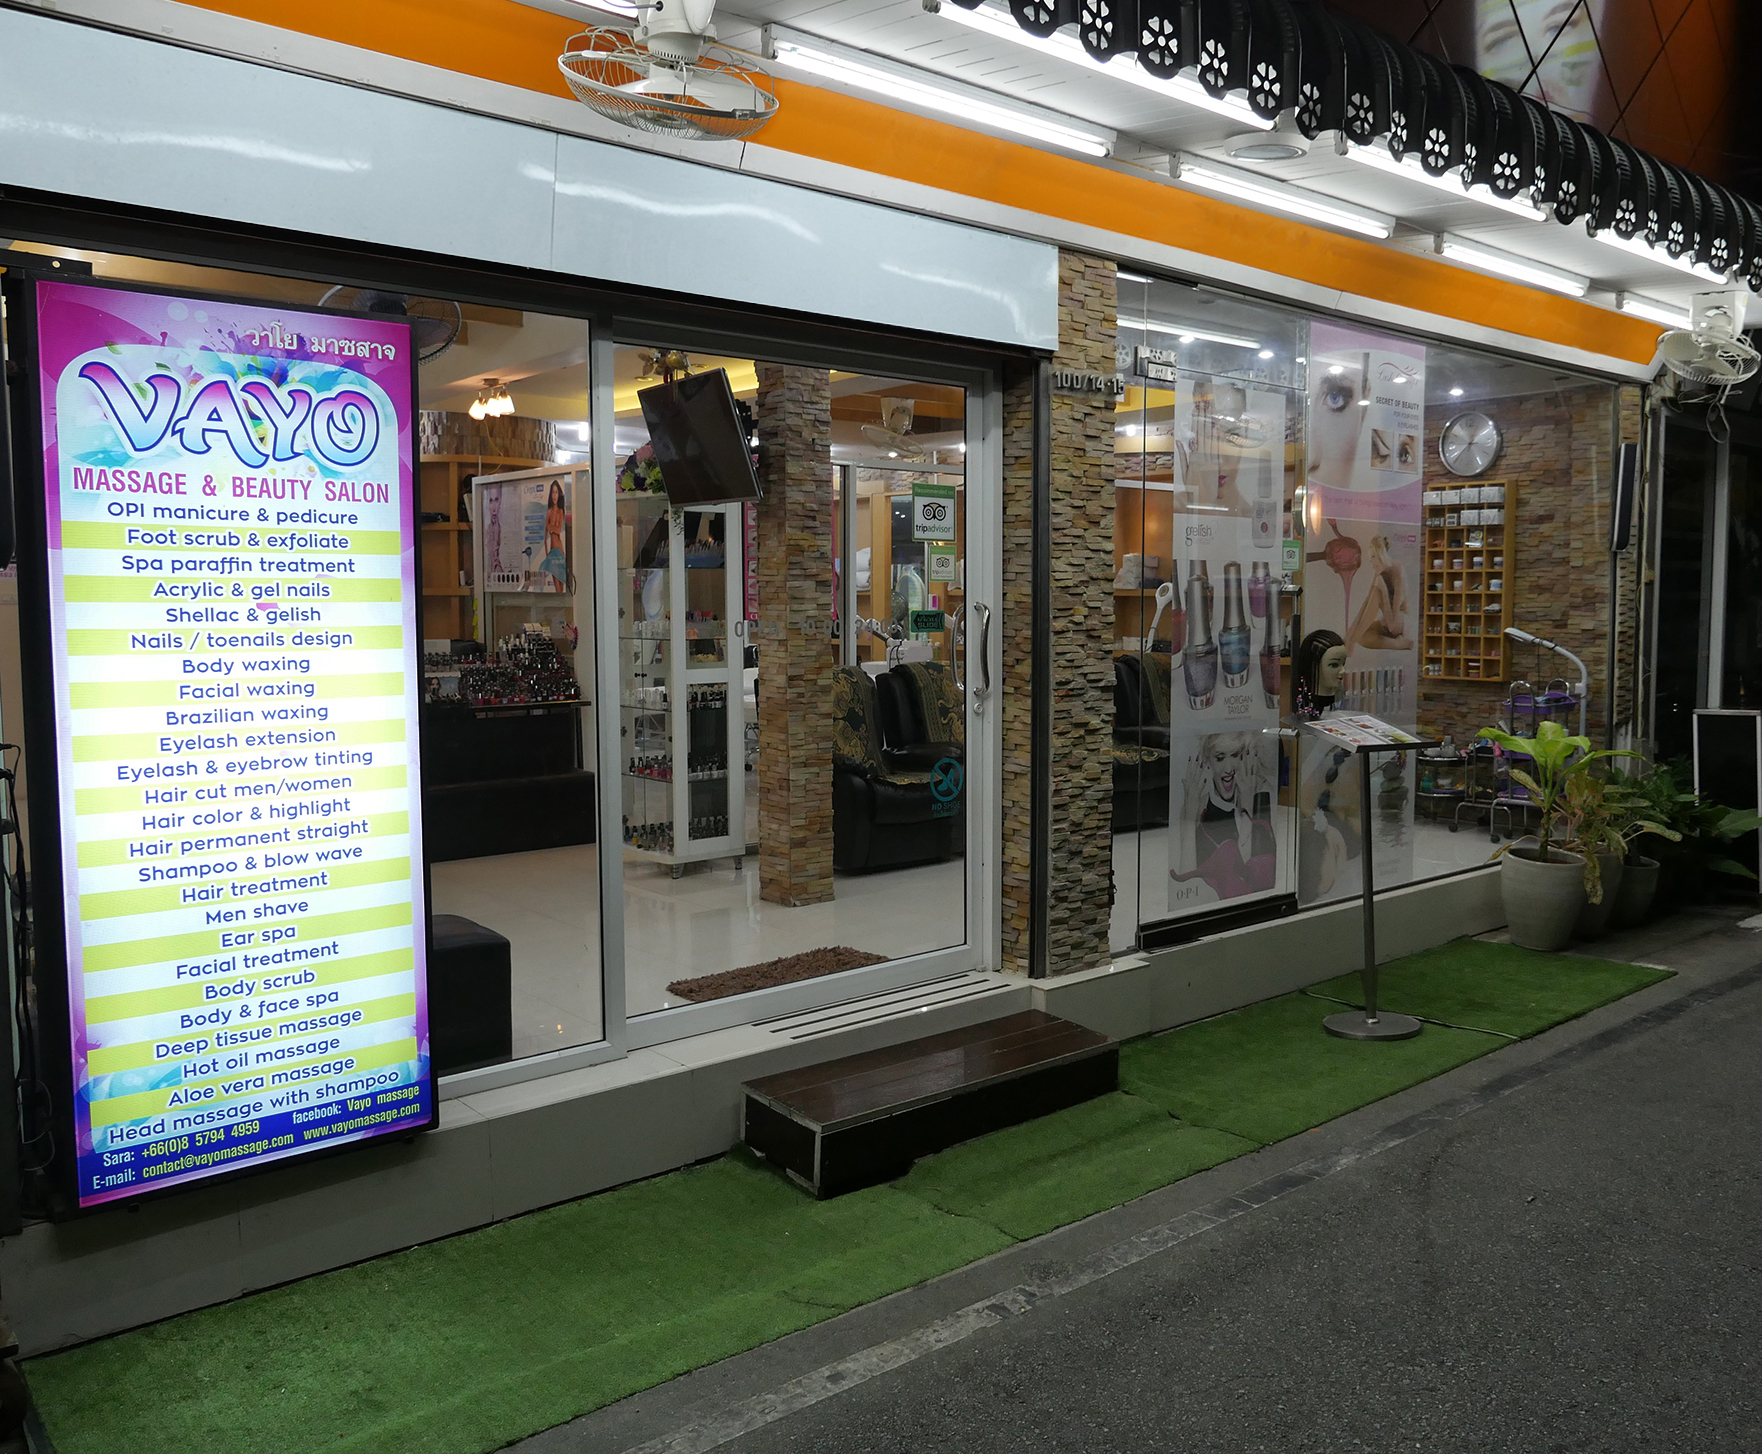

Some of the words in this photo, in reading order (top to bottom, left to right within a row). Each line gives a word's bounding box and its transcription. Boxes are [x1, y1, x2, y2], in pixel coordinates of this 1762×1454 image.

[246, 321, 298, 350] วาโย
[78, 361, 380, 468] VAYO
[1376, 396, 1394, 406] SECRET
[1402, 401, 1419, 410] BEAUTY
[73, 467, 187, 495] MASSAGE
[202, 474, 217, 497] &
[232, 476, 312, 500] BEAUTY
[325, 480, 389, 504] SALON
[107, 501, 145, 518] OPI
[153, 504, 250, 521] manicure
[256, 507, 269, 522] &
[276, 508, 358, 526] pedicure
[128, 529, 177, 545] Foot
[184, 531, 241, 546] scrub
[247, 532, 260, 547] &
[267, 532, 349, 551] exfoliate
[916, 524, 952, 534] tripadvisor
[1184, 523, 1212, 547] gelish
[121, 555, 163, 574] Spa
[171, 556, 252, 575] paraffin
[259, 557, 355, 573] treatment
[153, 581, 224, 600] Acrylic
[231, 582, 244, 597] &
[251, 582, 280, 600] gel
[287, 582, 330, 597] nails
[166, 607, 239, 623] Shellac
[246, 607, 259, 622] &
[266, 607, 321, 625] gelish
[734, 620, 780, 638] OPEN
[131, 633, 183, 649] Nails
[189, 632, 200, 650] /
[206, 631, 285, 648] toenails
[291, 631, 352, 648] design
[182, 658, 234, 676] Body
[241, 656, 310, 673] waxing
[179, 683, 239, 699] Facial
[246, 681, 315, 698] waxing
[1224, 694, 1253, 706] MORGAN
[166, 708, 254, 726] Brazilian
[261, 704, 328, 721] waxing
[1227, 705, 1250, 714] TAYLOR
[160, 733, 238, 754] Eyelash
[245, 728, 336, 747] extension
[117, 761, 198, 783] Eyelash
[205, 760, 218, 774] &
[226, 756, 308, 775] eyebrow
[314, 750, 373, 766] tinting
[145, 787, 188, 804] Hair
[195, 784, 227, 800] cut
[234, 777, 352, 797] men/women
[142, 813, 185, 830] Hair
[192, 809, 243, 826] color
[250, 806, 262, 820] &
[269, 798, 351, 820] highlight
[931, 802, 942, 810] NO
[943, 800, 960, 810] SHOE
[130, 839, 173, 857] Hair
[181, 827, 291, 856] permanent
[297, 819, 369, 840] straight
[138, 861, 238, 882] Shampoo
[245, 856, 257, 870] &
[264, 852, 309, 868] blow
[315, 847, 363, 862] wave
[182, 884, 224, 903] Hair
[230, 871, 328, 897] treatment
[206, 909, 246, 925] Men
[253, 901, 309, 919] shave
[221, 932, 255, 948] Ear
[261, 927, 296, 943] spa
[176, 956, 236, 979] Facial
[243, 941, 339, 969] treatment
[205, 979, 256, 1000] Body
[263, 969, 315, 990] scrub
[180, 1008, 232, 1029] Body
[239, 1004, 252, 1018] &
[258, 998, 300, 1019] face
[306, 991, 339, 1008] spa
[155, 1039, 209, 1059] Deep
[215, 1027, 272, 1047] tissue
[279, 1010, 362, 1036] massage
[183, 1058, 220, 1079] Hot
[225, 1052, 249, 1070] oil
[255, 1038, 340, 1064] massage
[168, 1087, 215, 1107] Aloe
[221, 1076, 264, 1095] vera
[271, 1058, 355, 1085] massage
[109, 1118, 166, 1145] Head
[173, 1101, 264, 1131] massage
[269, 1088, 310, 1109] with
[315, 1071, 401, 1101] shampoo
[292, 1102, 342, 1125] facebook:
[346, 1097, 372, 1112] Vayo
[377, 1085, 420, 1105] massage
[93, 1168, 136, 1189] E-mail:
[141, 1128, 294, 1180] contact@vayomassage.com
[302, 1097, 420, 1140] www.vayomassage.com
[103, 1151, 135, 1167] Sara:
[141, 1136, 189, 1158] +66(0)8
[195, 1128, 225, 1146] 5794
[230, 1120, 260, 1138] 4959
